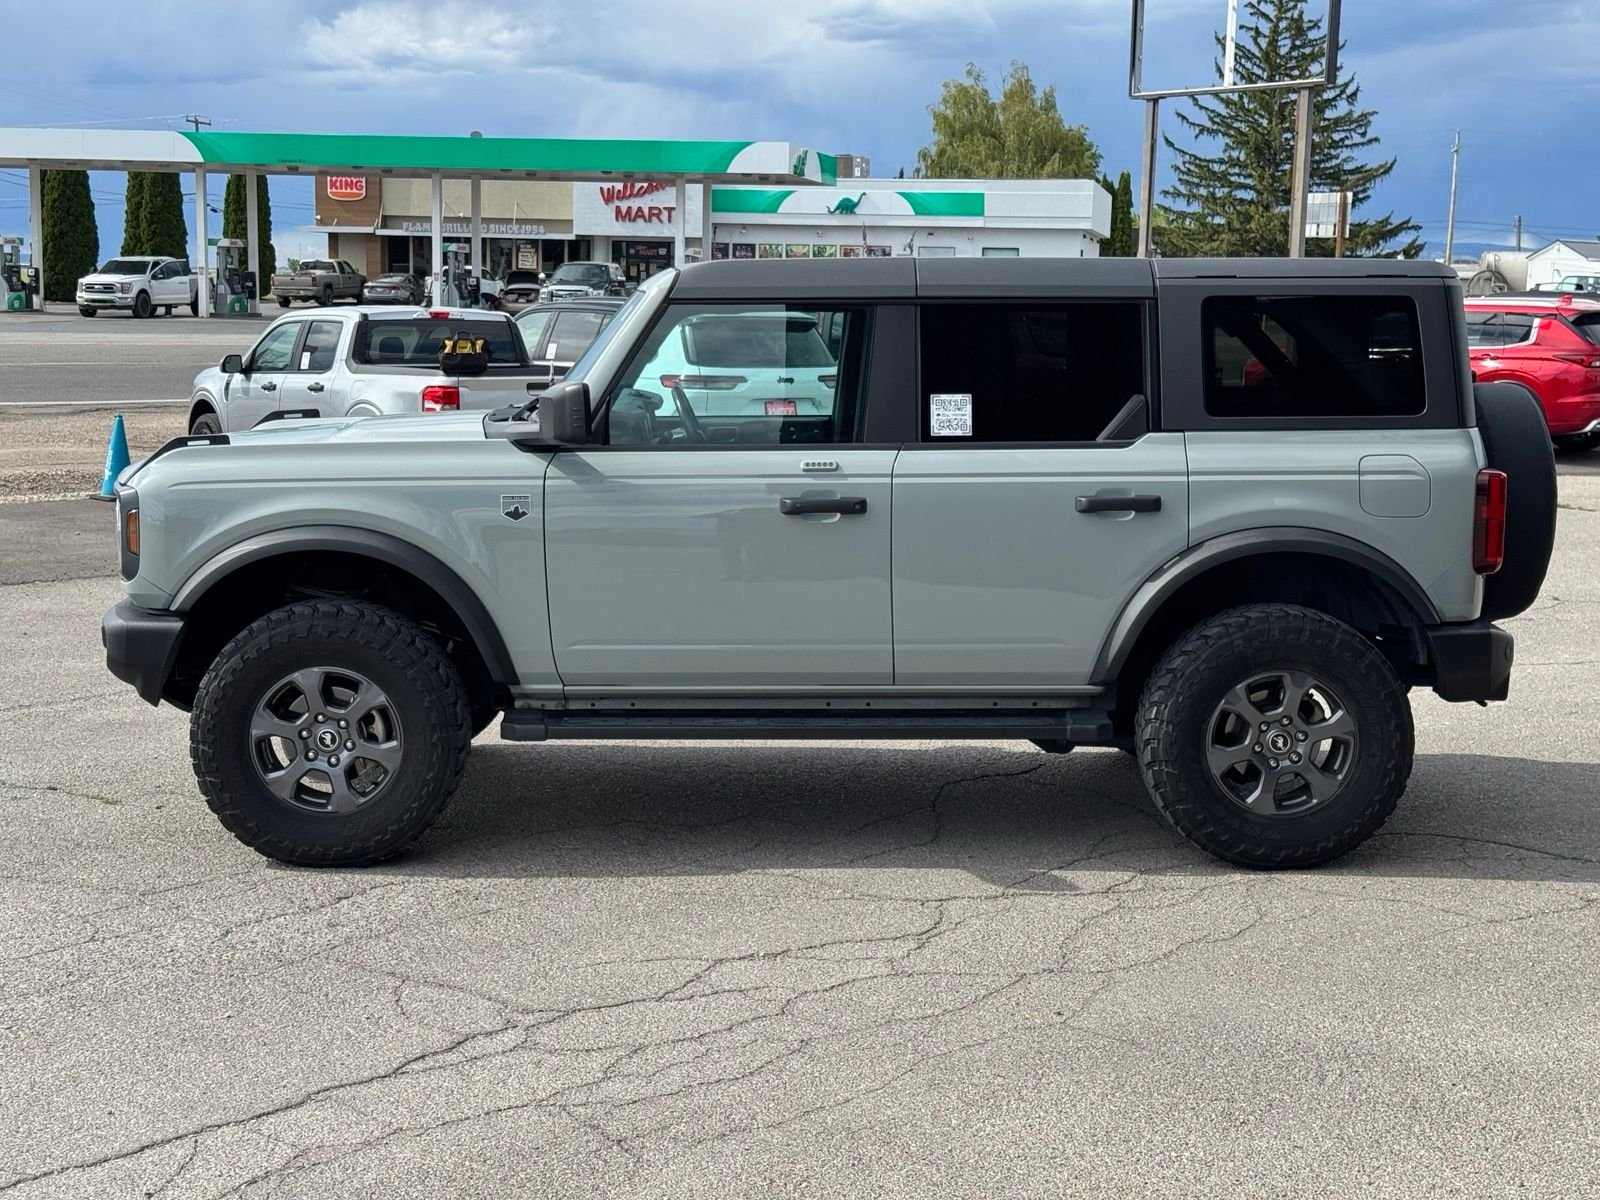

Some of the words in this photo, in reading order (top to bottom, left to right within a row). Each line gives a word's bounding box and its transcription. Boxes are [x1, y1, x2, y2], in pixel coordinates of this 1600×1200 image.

[329, 179, 364, 191] KING
[615, 205, 676, 224] MART
[402, 222, 433, 232] FLAM
[489, 224, 520, 234] SINCE
[520, 224, 545, 235] 1954
